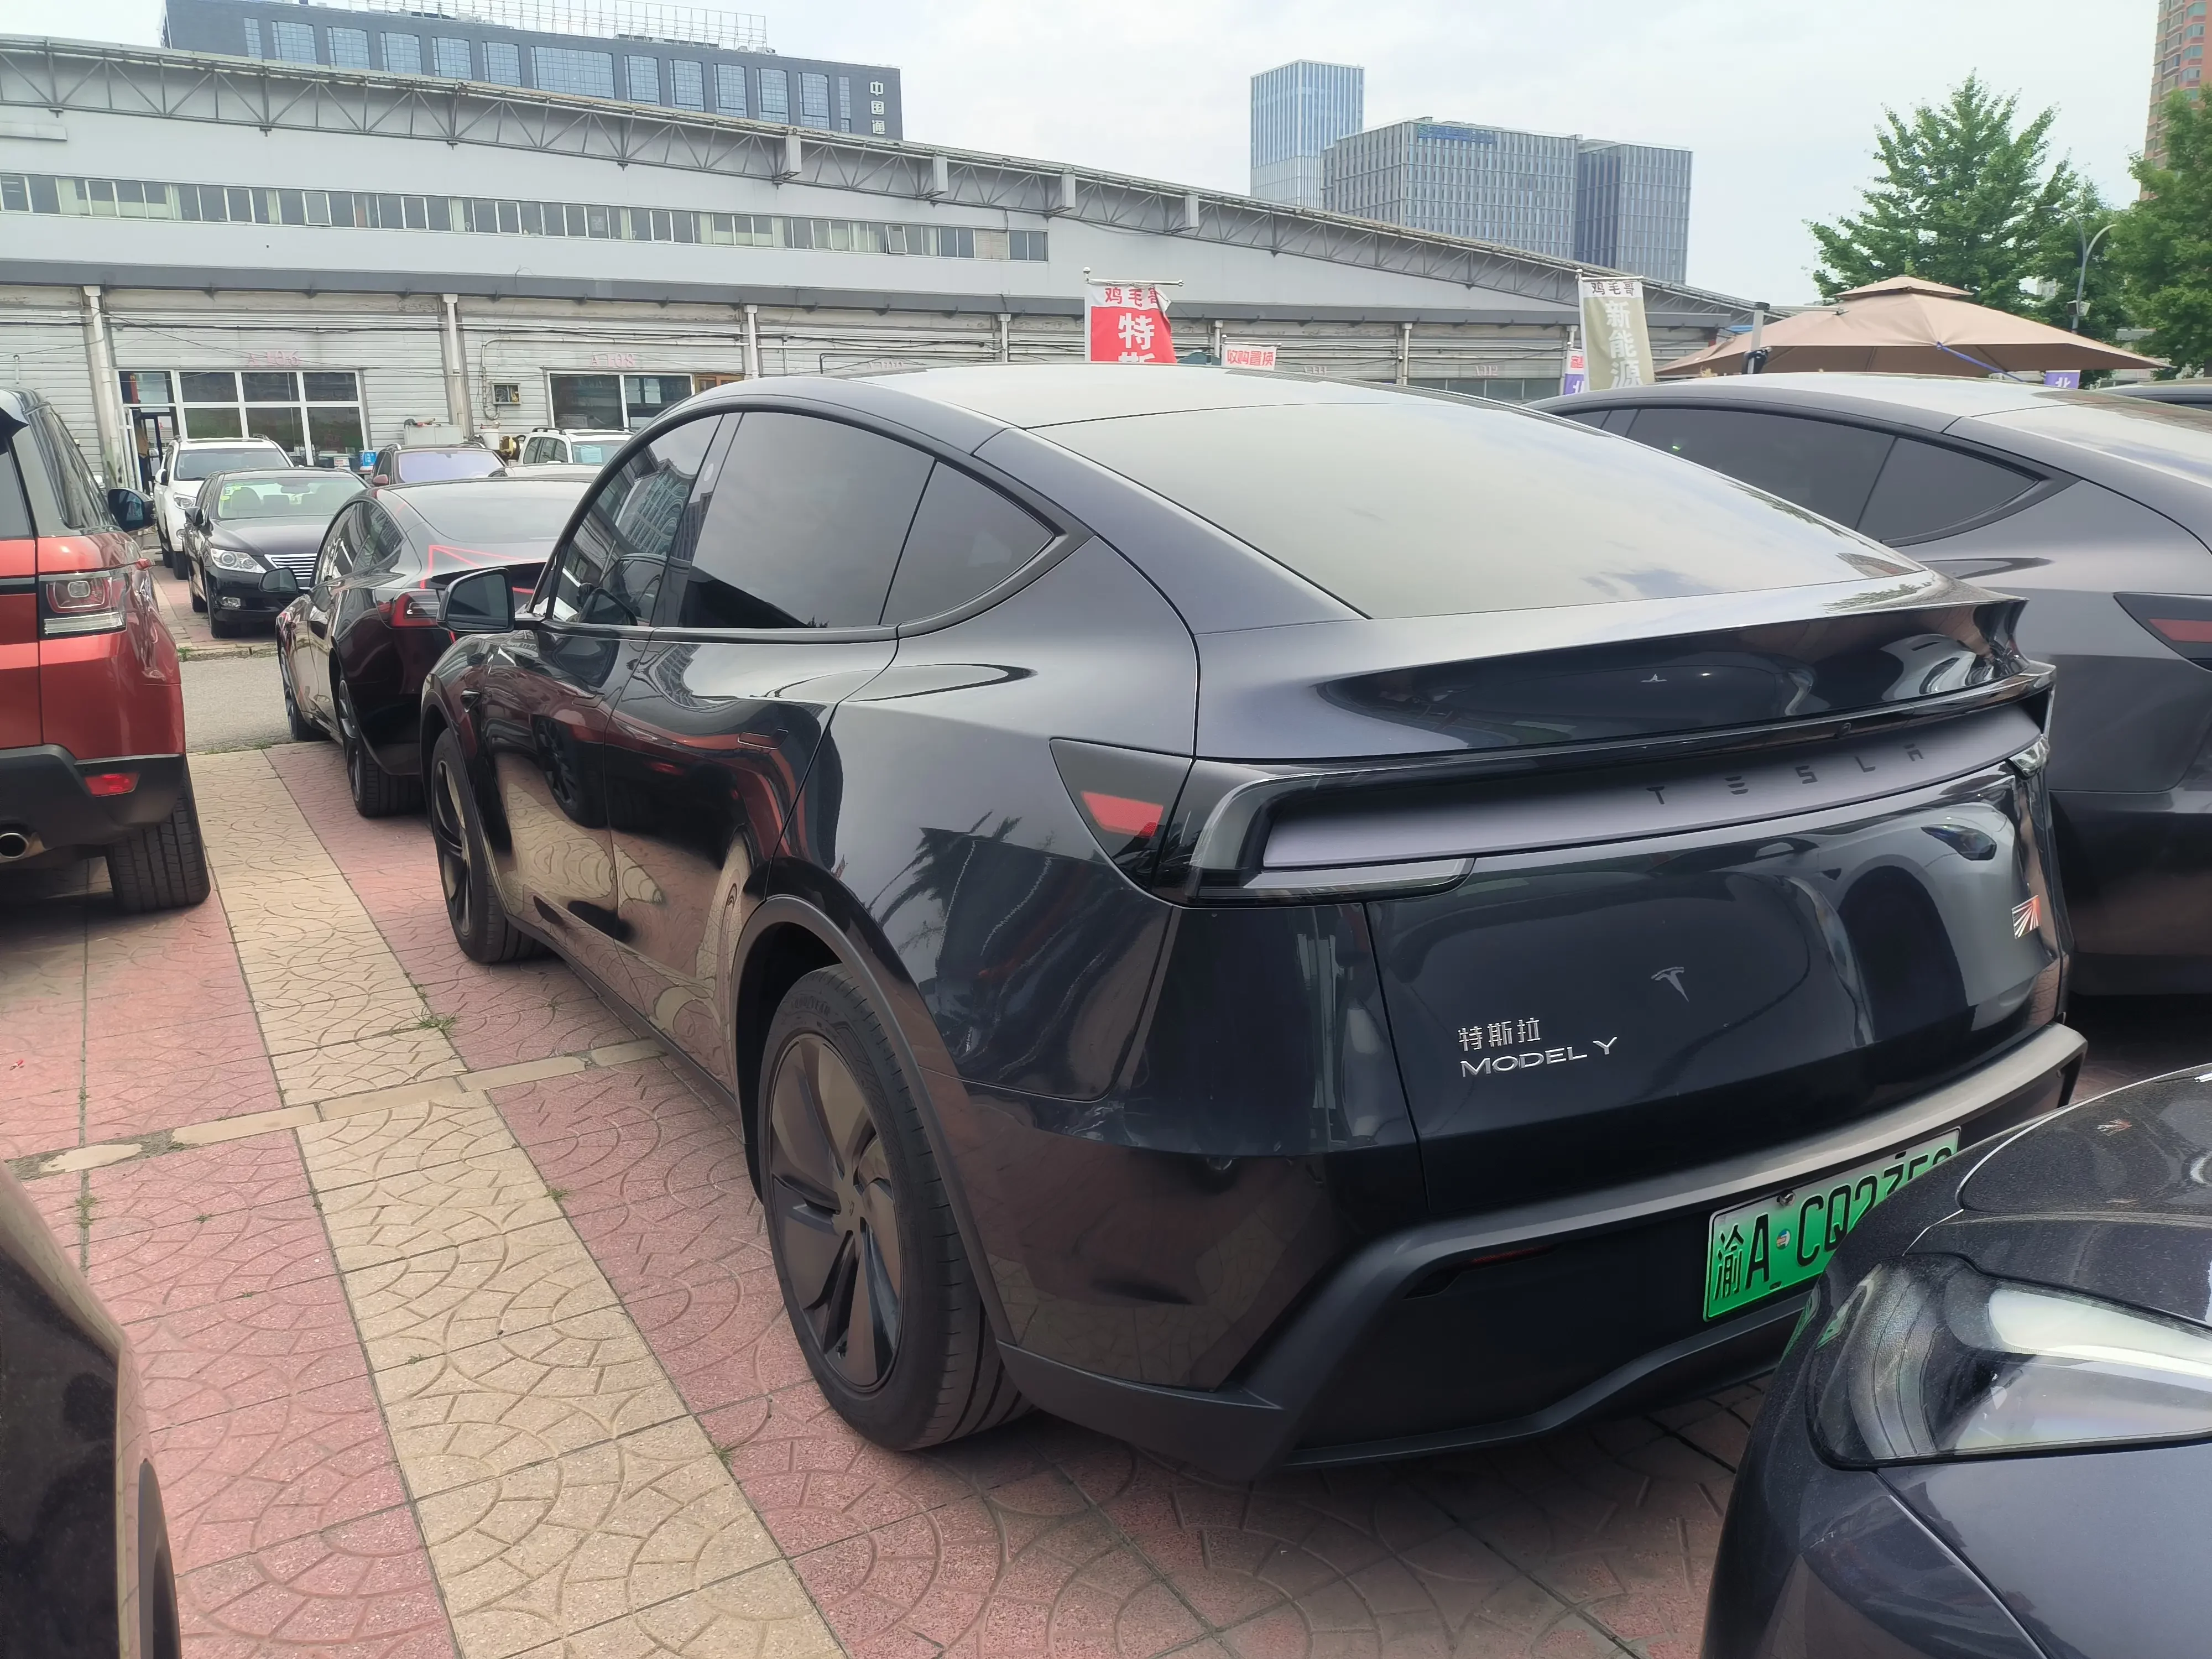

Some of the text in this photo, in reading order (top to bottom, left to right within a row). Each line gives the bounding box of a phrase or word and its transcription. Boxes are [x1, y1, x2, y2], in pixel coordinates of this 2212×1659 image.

[870, 81, 886, 134] 中国通
[1591, 281, 1635, 296] 鸡毛哥
[1227, 349, 1274, 366] 收购置换
[1605, 300, 1644, 388] 新能源
[1645, 743, 1924, 805] TESLA
[1457, 1016, 1542, 1052] 特斯拉
[1459, 1036, 1618, 1078] MODEL Y
